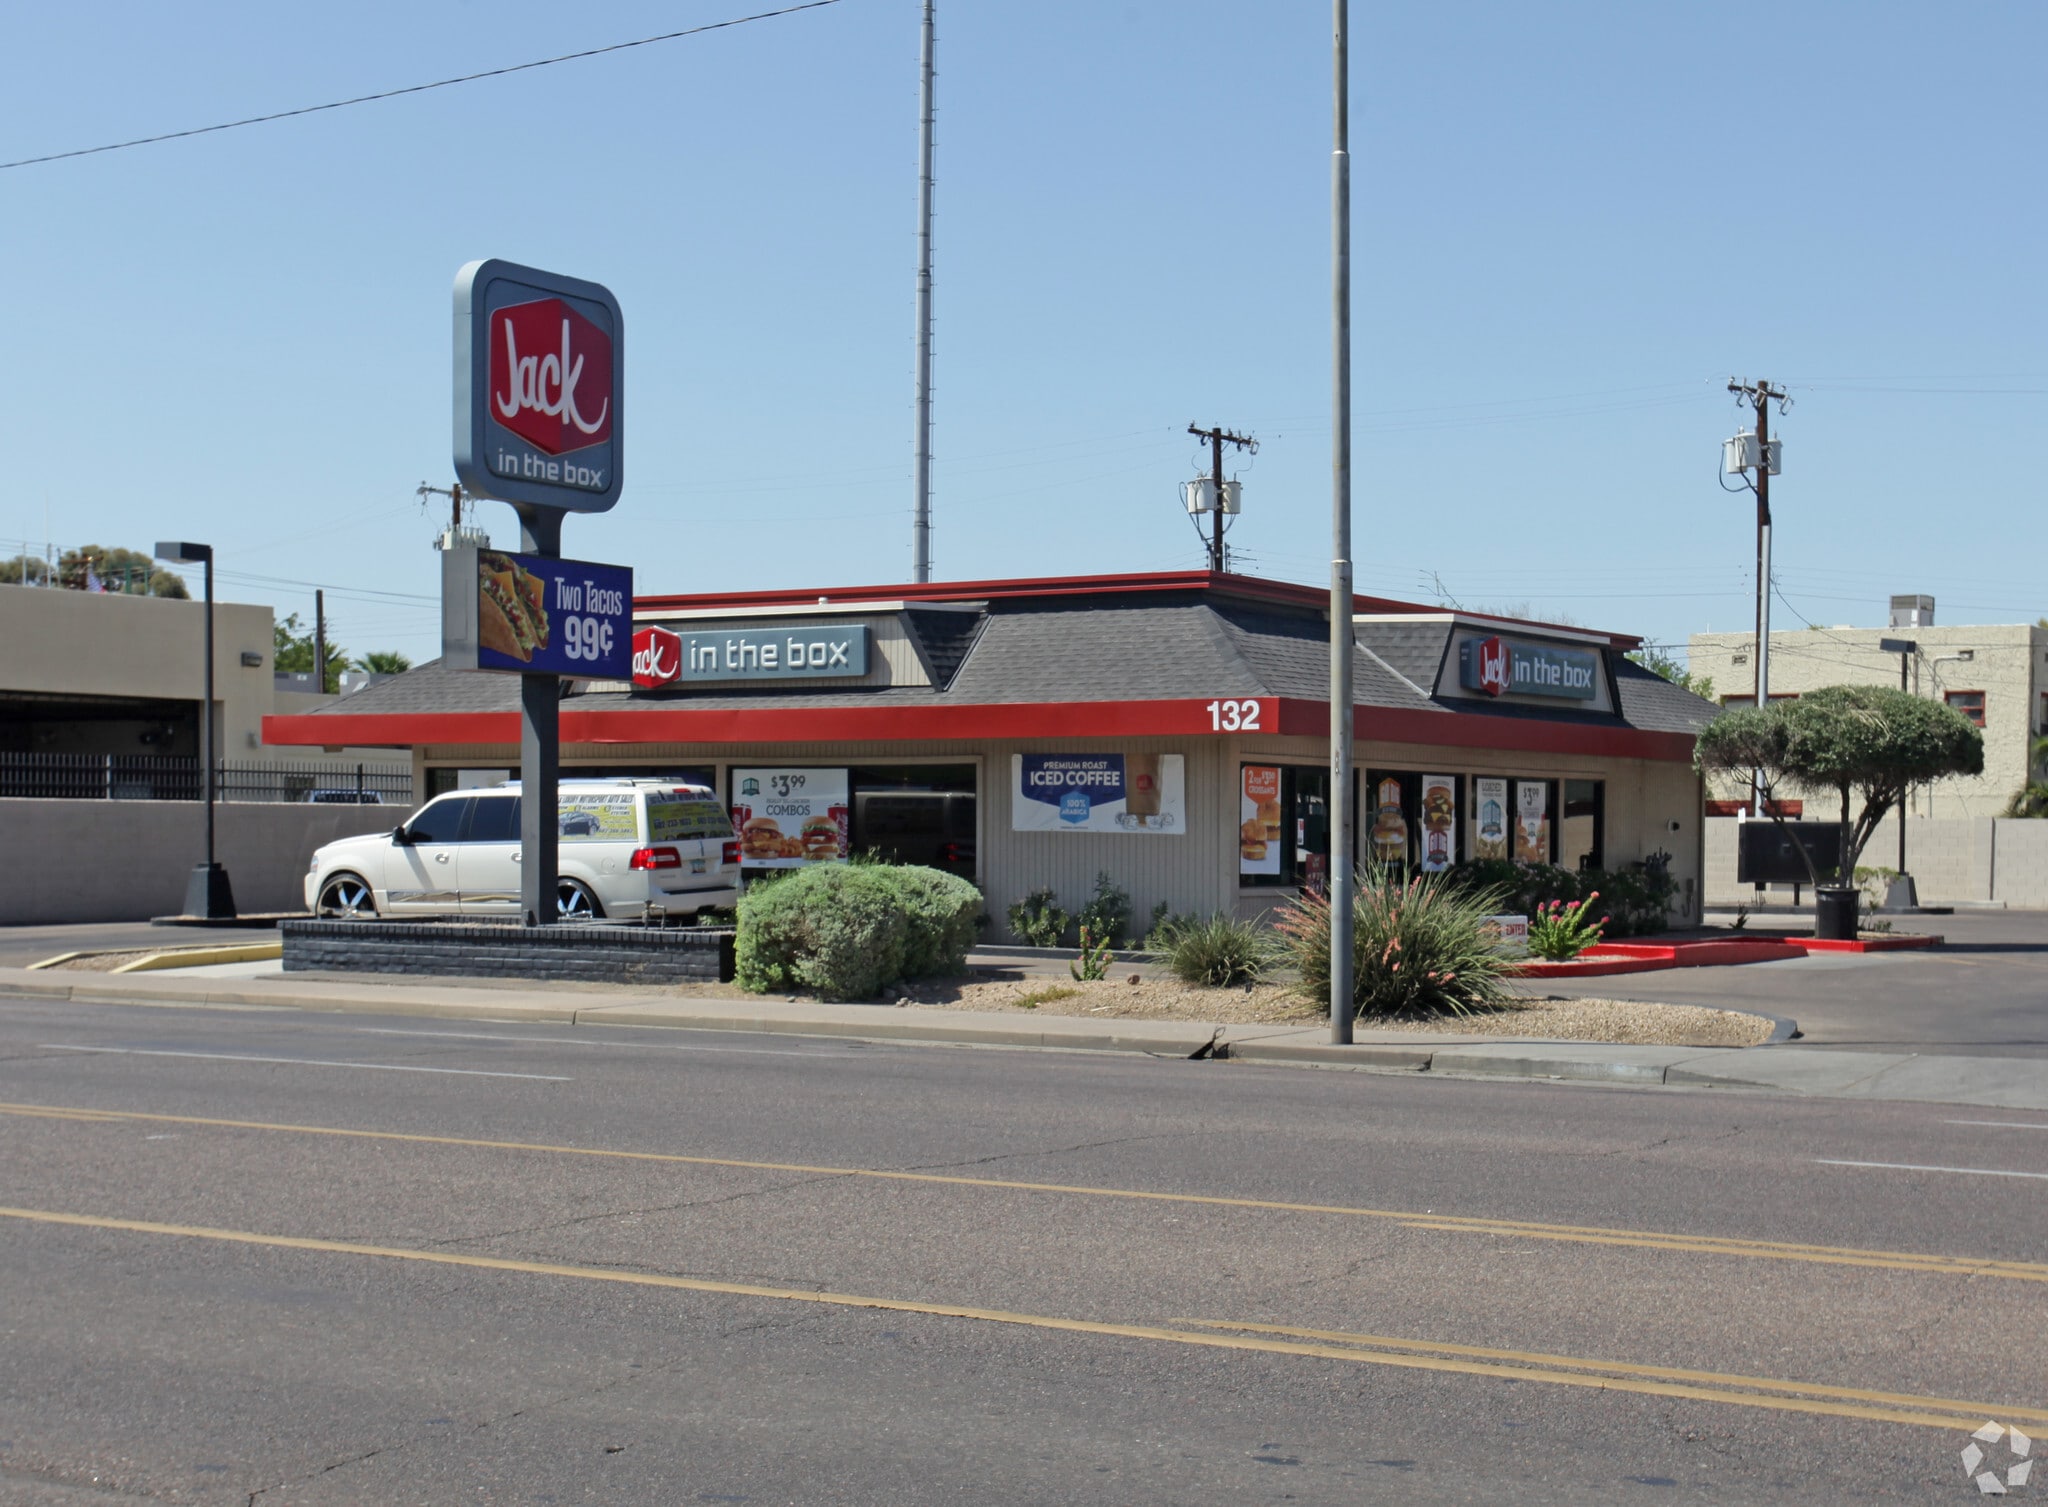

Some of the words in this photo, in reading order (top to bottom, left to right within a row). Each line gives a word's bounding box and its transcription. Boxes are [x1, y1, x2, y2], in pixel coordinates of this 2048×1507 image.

[496, 318, 608, 434] Jack
[498, 447, 518, 474] in
[523, 453, 559, 481] the
[564, 460, 602, 487] box
[554, 576, 582, 612] Two
[583, 580, 623, 616] Tacos
[564, 615, 614, 661] 99¢
[632, 633, 678, 679] ack
[690, 639, 717, 670] in
[726, 638, 778, 668] the
[787, 637, 848, 667] box
[1481, 643, 1511, 688] Jack
[1515, 654, 1530, 683] in
[1534, 658, 1560, 686] the
[1563, 660, 1593, 688] box
[1207, 700, 1260, 731] 132
[1030, 771, 1064, 787] ICED
[1066, 771, 1120, 787] COFFEE
[1043, 761, 1081, 770] PREMIUM
[1082, 761, 1108, 769] ROAST
[766, 804, 811, 816] COMBOS
[1061, 808, 1087, 816] ARABICA
[1066, 799, 1086, 808] 100%
